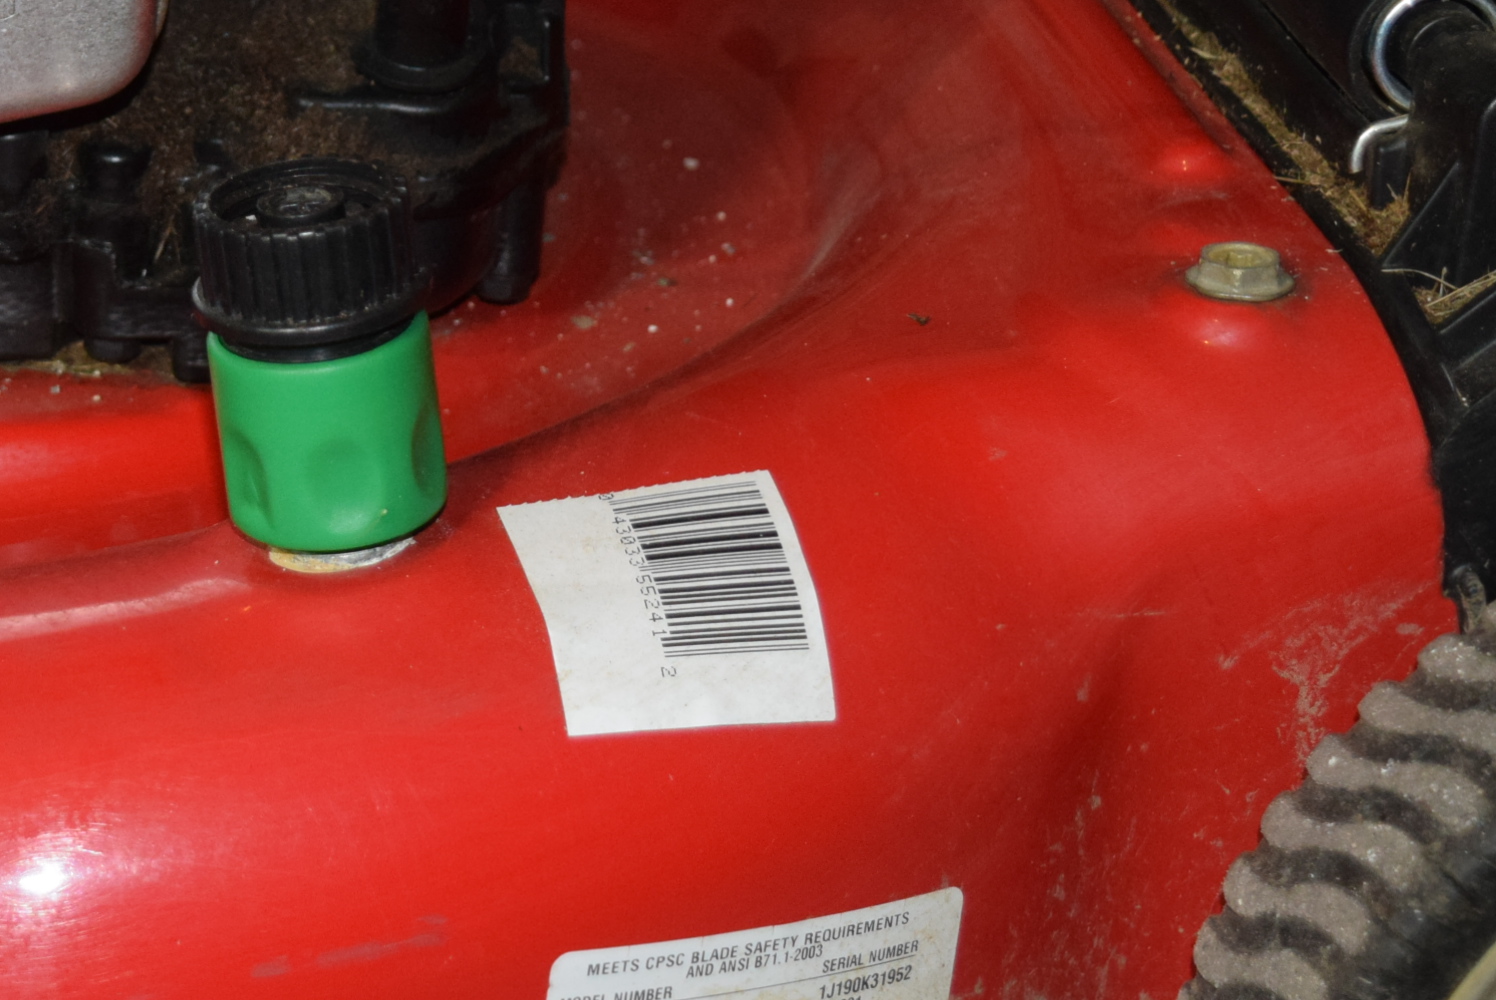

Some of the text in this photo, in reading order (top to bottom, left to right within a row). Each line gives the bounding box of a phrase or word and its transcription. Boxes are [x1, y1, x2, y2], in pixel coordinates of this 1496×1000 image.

[612, 516, 646, 566] 43033
[636, 574, 668, 637] 55241
[660, 665, 677, 678] 2
[587, 911, 910, 976] MEETS CPSC BLADE SAFETY REQUIREMENTS
[822, 939, 920, 974] SERIAL NUMBER
[686, 944, 824, 979] AND ANSI B71.1-2003
[613, 986, 673, 1000] NUMBER
[819, 964, 913, 1000] 1J190K31952
